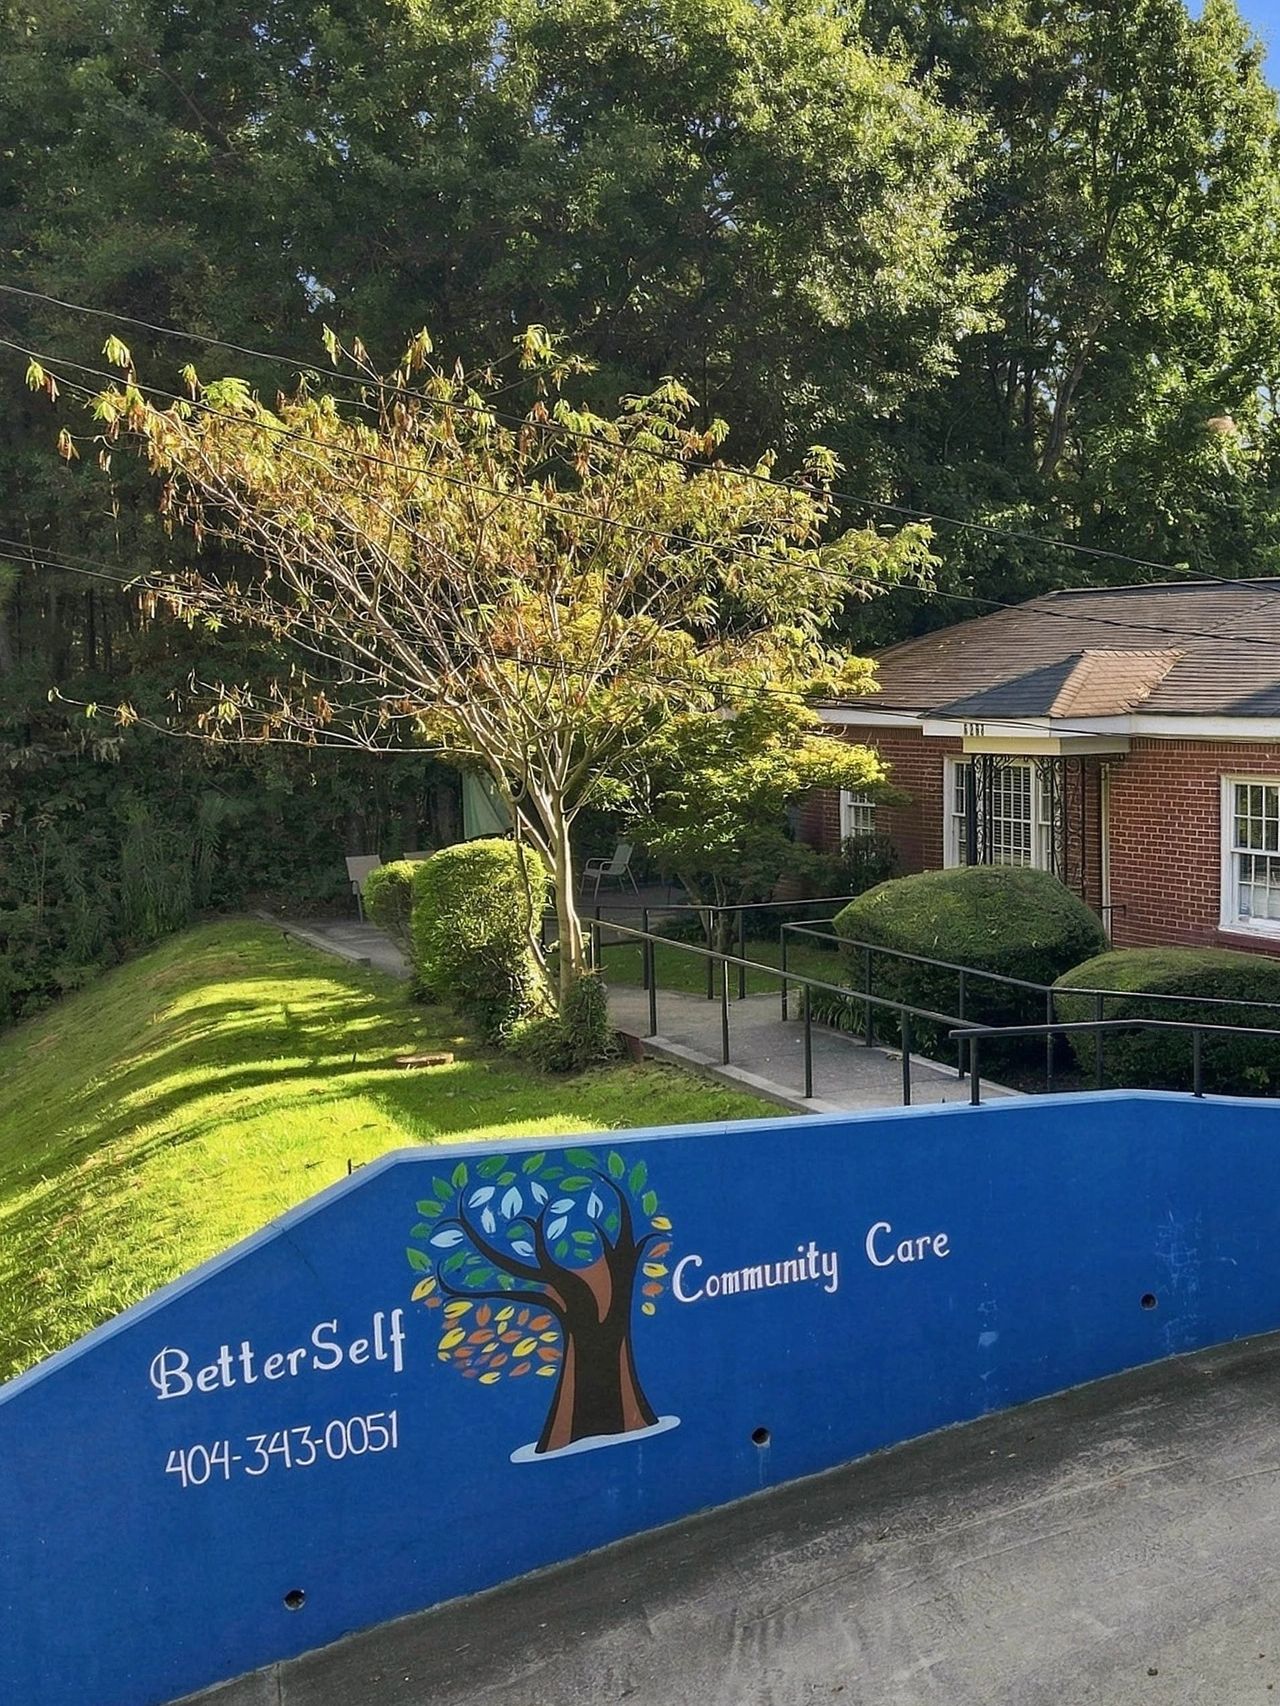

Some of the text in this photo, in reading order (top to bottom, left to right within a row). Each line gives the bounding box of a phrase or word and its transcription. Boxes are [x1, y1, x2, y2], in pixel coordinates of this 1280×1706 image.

[672, 1222, 950, 1303] Community Care
[150, 1308, 406, 1400] BetterSelf
[165, 1410, 398, 1488] 404-343-0051
